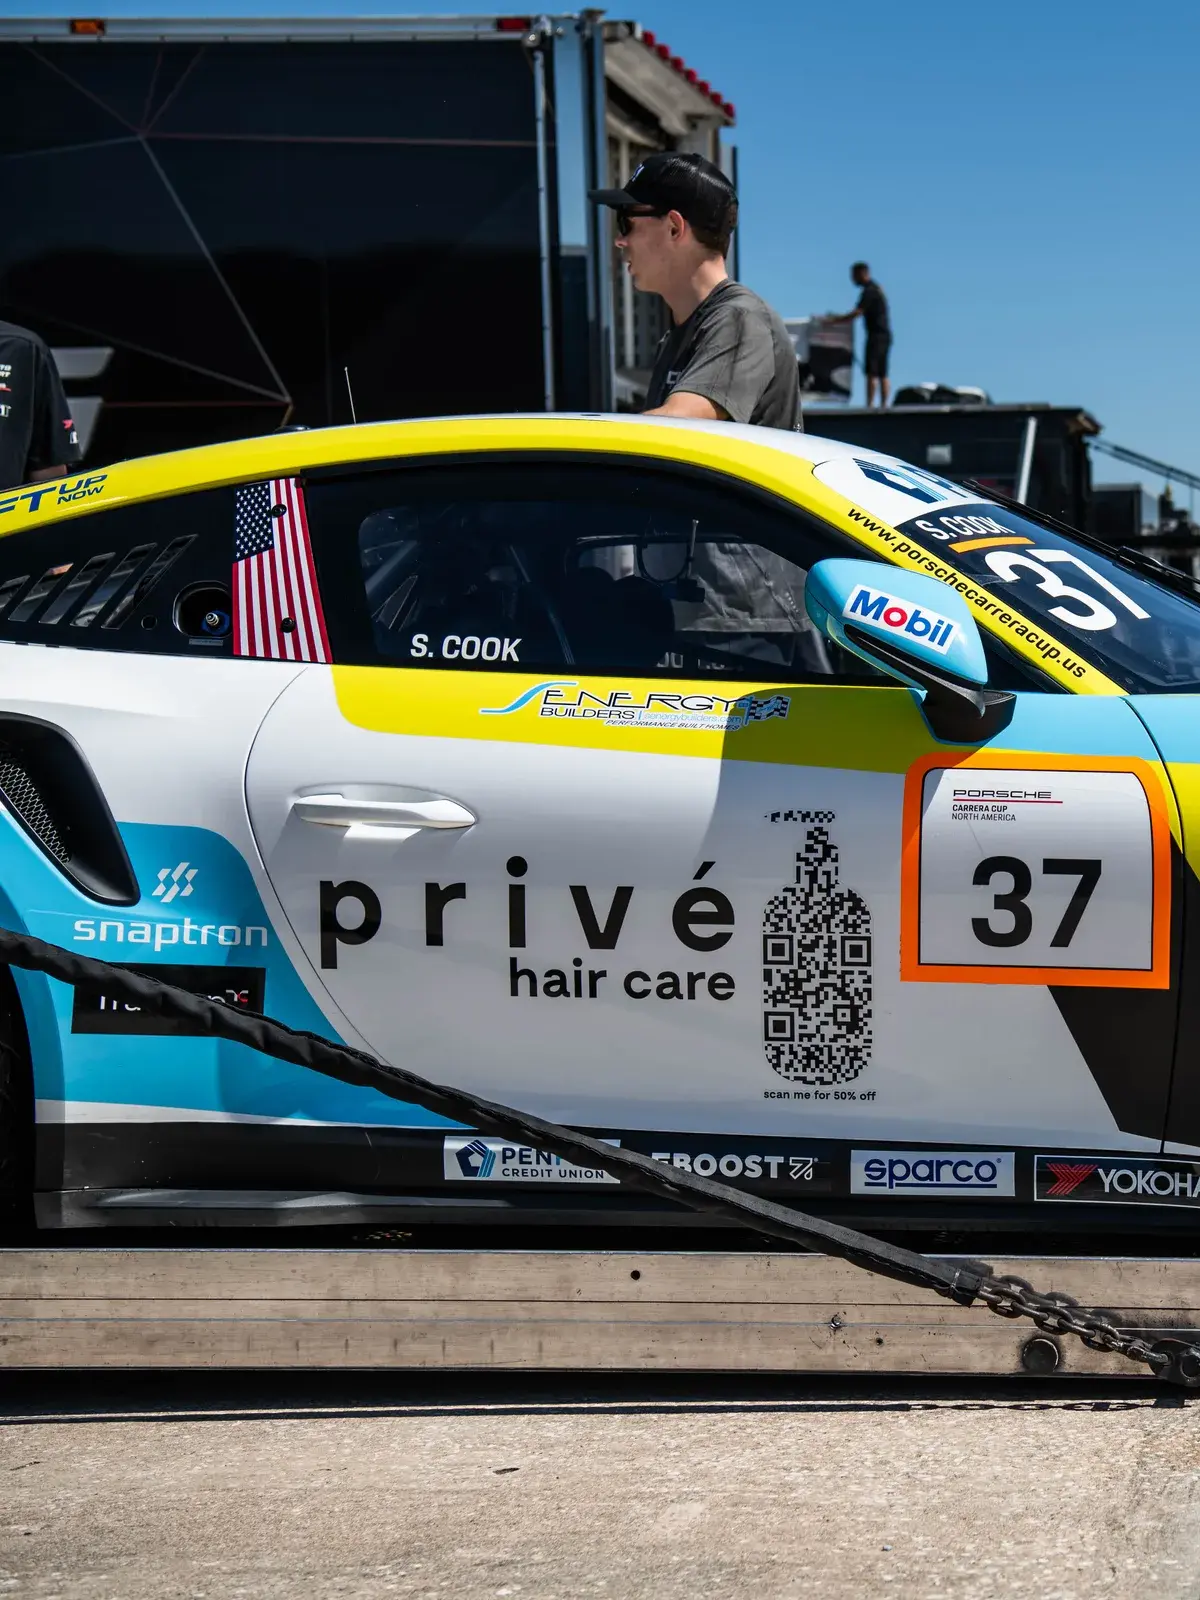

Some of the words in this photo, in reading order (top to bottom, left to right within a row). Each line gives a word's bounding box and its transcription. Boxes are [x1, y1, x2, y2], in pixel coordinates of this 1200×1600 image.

[57, 485, 104, 505] NOW
[59, 474, 107, 494] UP
[847, 508, 1087, 679] www.porschecarreracup.us
[985, 549, 1151, 631] 37
[850, 590, 954, 647] Mobil
[410, 634, 434, 659] S.
[441, 635, 522, 663] COOK
[540, 707, 635, 720] BUILDERS
[606, 719, 678, 729] PERFORMANCE
[953, 789, 1052, 799] PORSCHE
[951, 813, 979, 821] NORTH
[980, 813, 1017, 822] AMERICA
[952, 804, 990, 813] CARRERA
[991, 805, 1008, 813] CUP
[319, 855, 736, 969] privé
[971, 855, 1102, 948] 37
[73, 916, 268, 951] snaptron
[509, 957, 608, 999] hair
[623, 967, 736, 1001] care
[763, 1091, 790, 1099] scan
[814, 1090, 831, 1100] for
[833, 1091, 857, 1100] 50%
[859, 1091, 877, 1100] off
[501, 1167, 552, 1178] CREDIT
[558, 1169, 605, 1179] UNION
[864, 1158, 998, 1189] sparco
